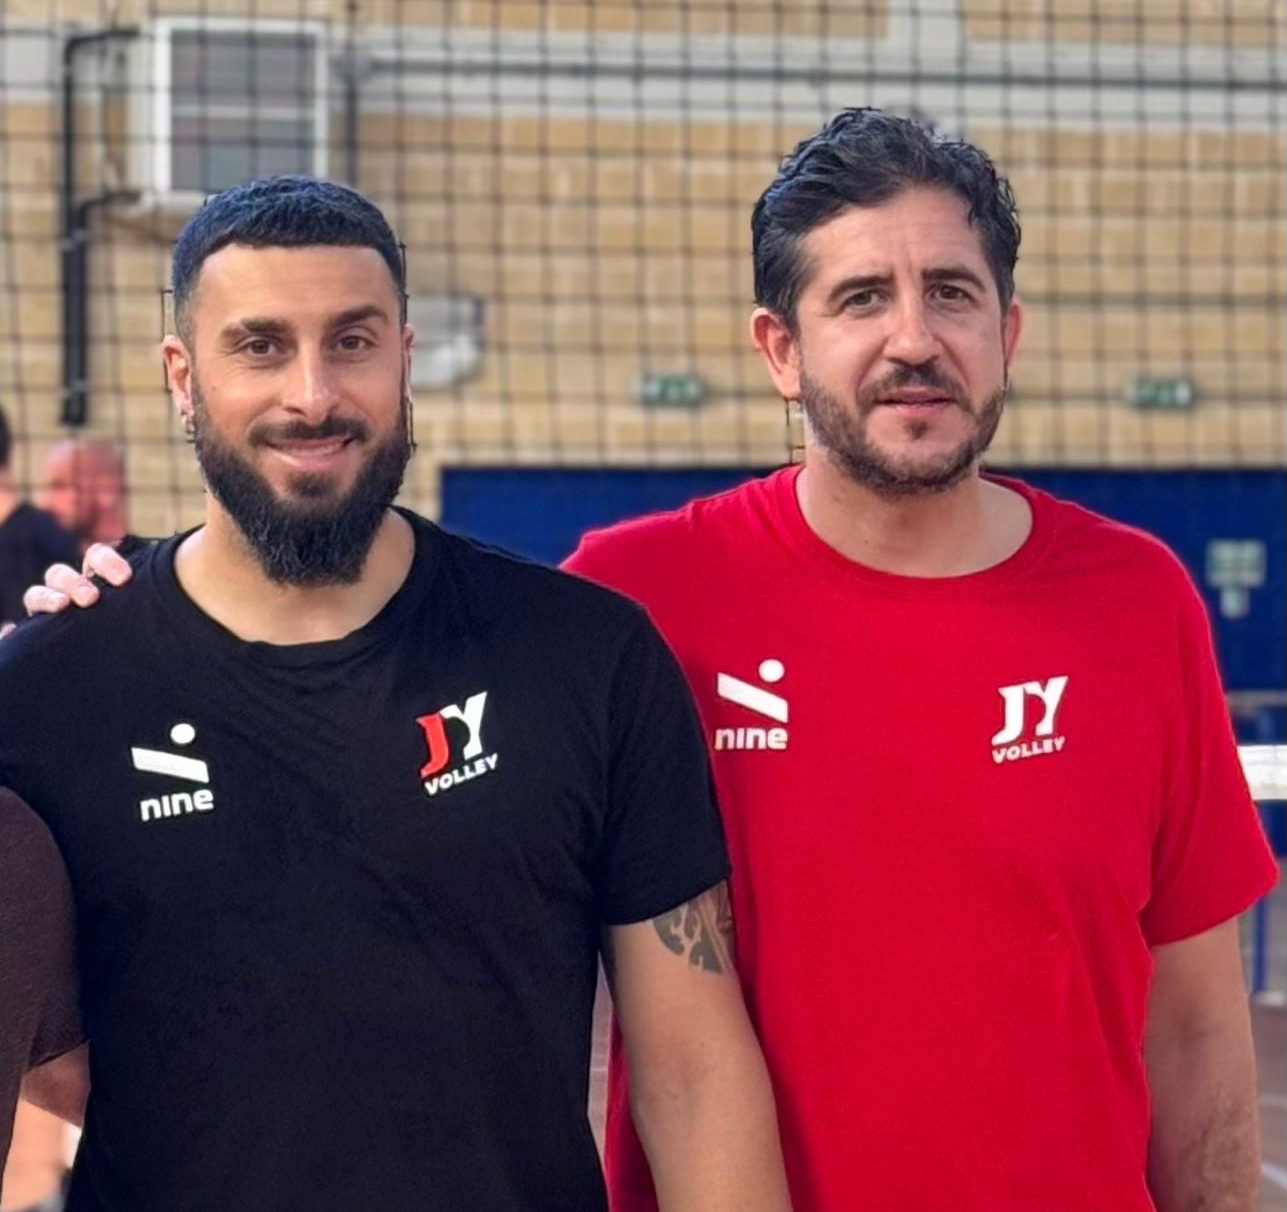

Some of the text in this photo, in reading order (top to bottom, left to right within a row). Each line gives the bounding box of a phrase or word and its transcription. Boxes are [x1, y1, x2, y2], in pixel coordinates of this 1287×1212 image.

[991, 675, 1068, 746] JY
[415, 691, 488, 778] JY
[714, 727, 788, 751] nine
[992, 736, 1066, 764] VOLLEY
[424, 753, 498, 796] VOLLEY
[139, 788, 214, 822] nine
